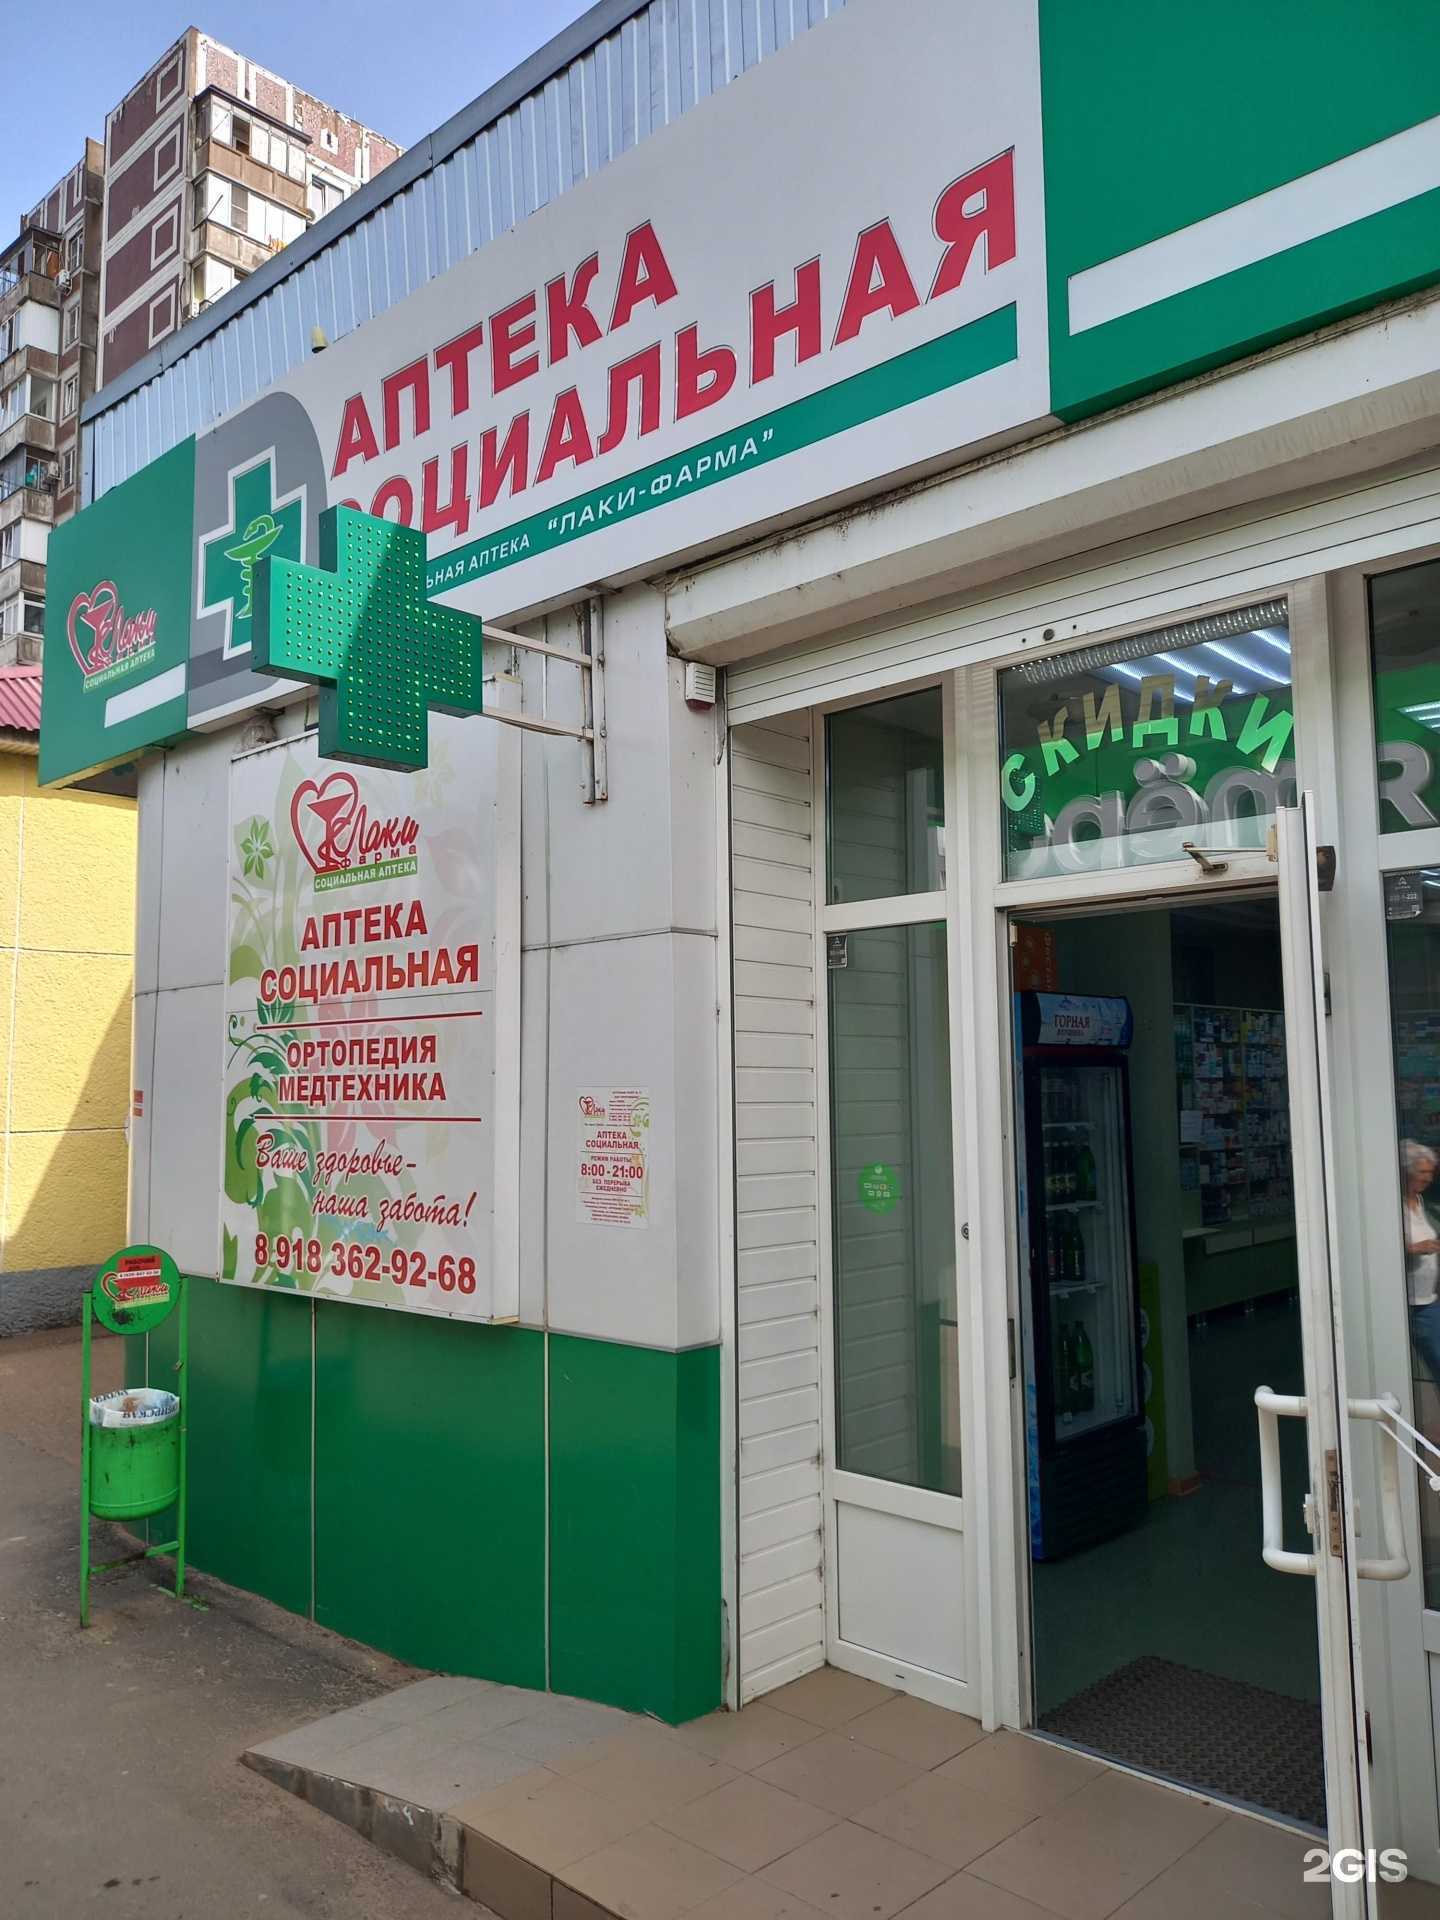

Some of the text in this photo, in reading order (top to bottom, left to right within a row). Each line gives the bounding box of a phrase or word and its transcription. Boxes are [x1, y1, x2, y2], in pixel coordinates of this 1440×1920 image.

[331, 219, 679, 481] АПТЕКА
[337, 145, 1017, 538] ОЦИАЛЬНАЯ
[468, 533, 530, 572] АПТЕКА
[315, 861, 417, 889] СОЦИАЛЬНАЯ АПТЕКА
[300, 900, 428, 951] АПТЕКА
[260, 944, 479, 1004] СОЦИАЛЬНАЯ
[1054, 1014, 1090, 1029] ГОРНАЯ
[286, 1035, 437, 1070] ОРТОПЕДИЯ
[279, 1072, 447, 1107] МЕДТЕХНИКА
[255, 1133, 307, 1172] Ваше
[585, 1140, 640, 1150] СОЦИАЛЬНАЯ
[597, 1130, 627, 1139] АПТЕКА
[581, 1163, 605, 1177] 8:00
[612, 1165, 644, 1179] 21:00
[311, 1190, 478, 1233] наша забота!
[255, 1233, 478, 1295] 8 918 362-92-68
